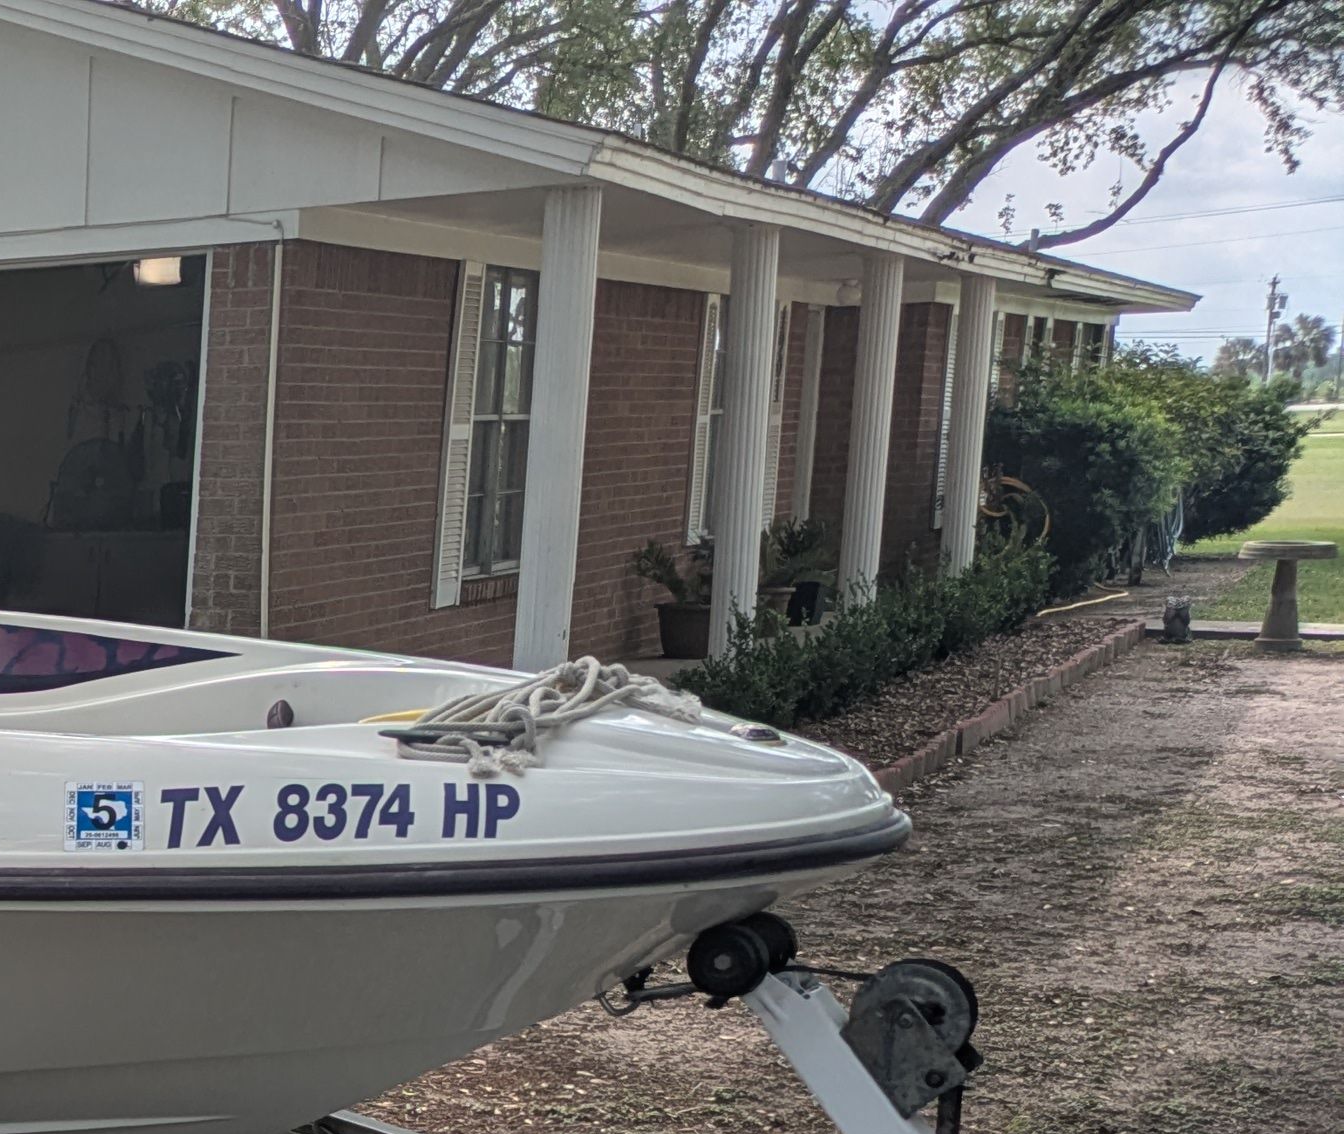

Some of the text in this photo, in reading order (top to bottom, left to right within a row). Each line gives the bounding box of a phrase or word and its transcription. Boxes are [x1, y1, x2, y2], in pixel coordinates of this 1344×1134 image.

[91, 793, 117, 830] 5
[160, 783, 521, 848] TX 8374 HP
